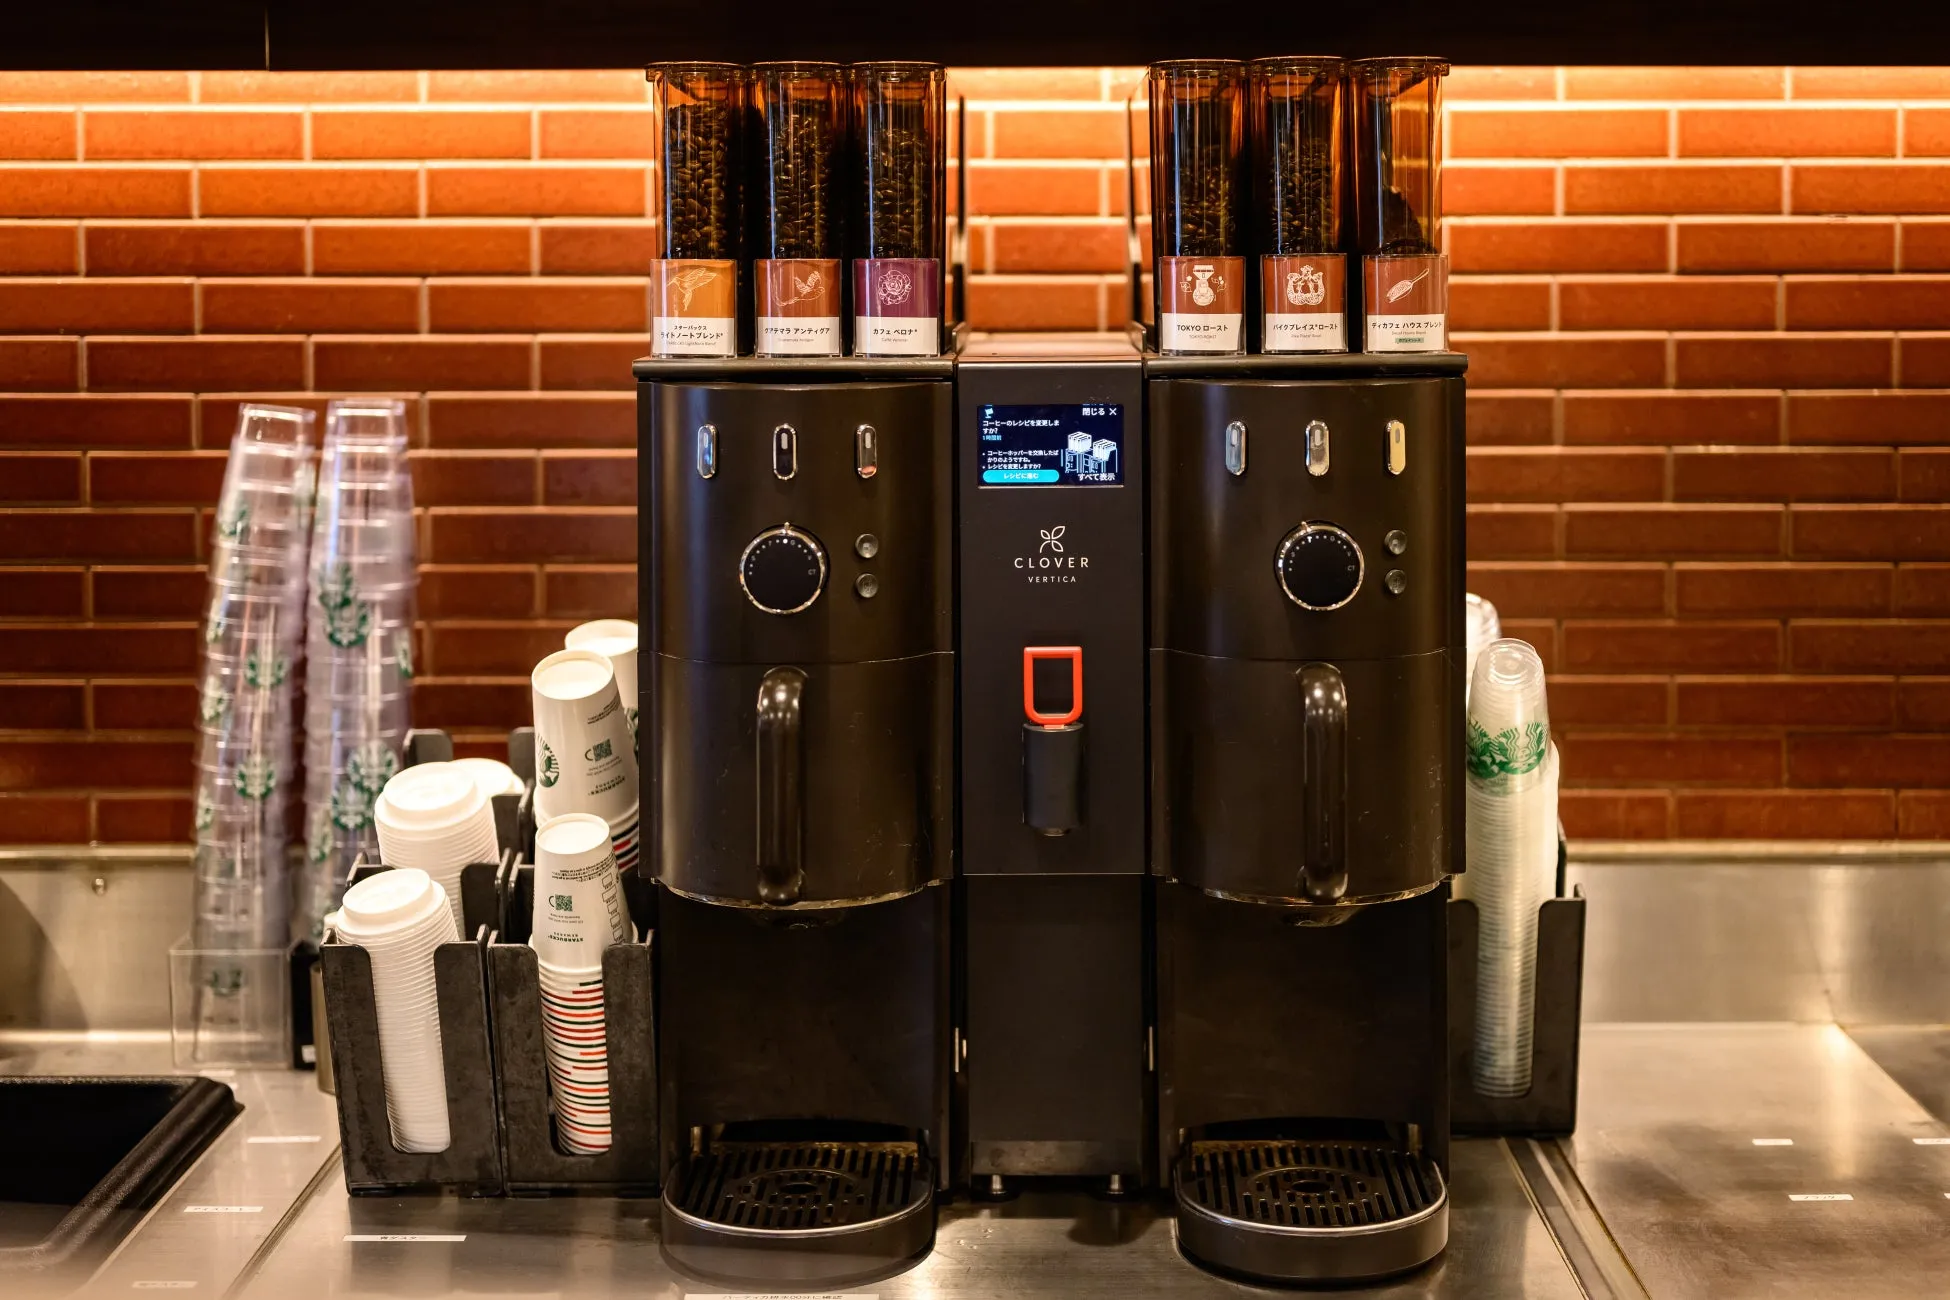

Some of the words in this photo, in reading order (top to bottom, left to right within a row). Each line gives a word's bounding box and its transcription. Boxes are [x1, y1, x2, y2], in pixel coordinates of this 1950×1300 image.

[793, 327, 830, 335] アンティグア
[1177, 324, 1201, 332] TOKYO
[1203, 324, 1229, 332] ロースト
[1082, 407, 1106, 416] 閉じる
[1077, 472, 1116, 482] すべて表示
[1014, 557, 1089, 569] CLOVER
